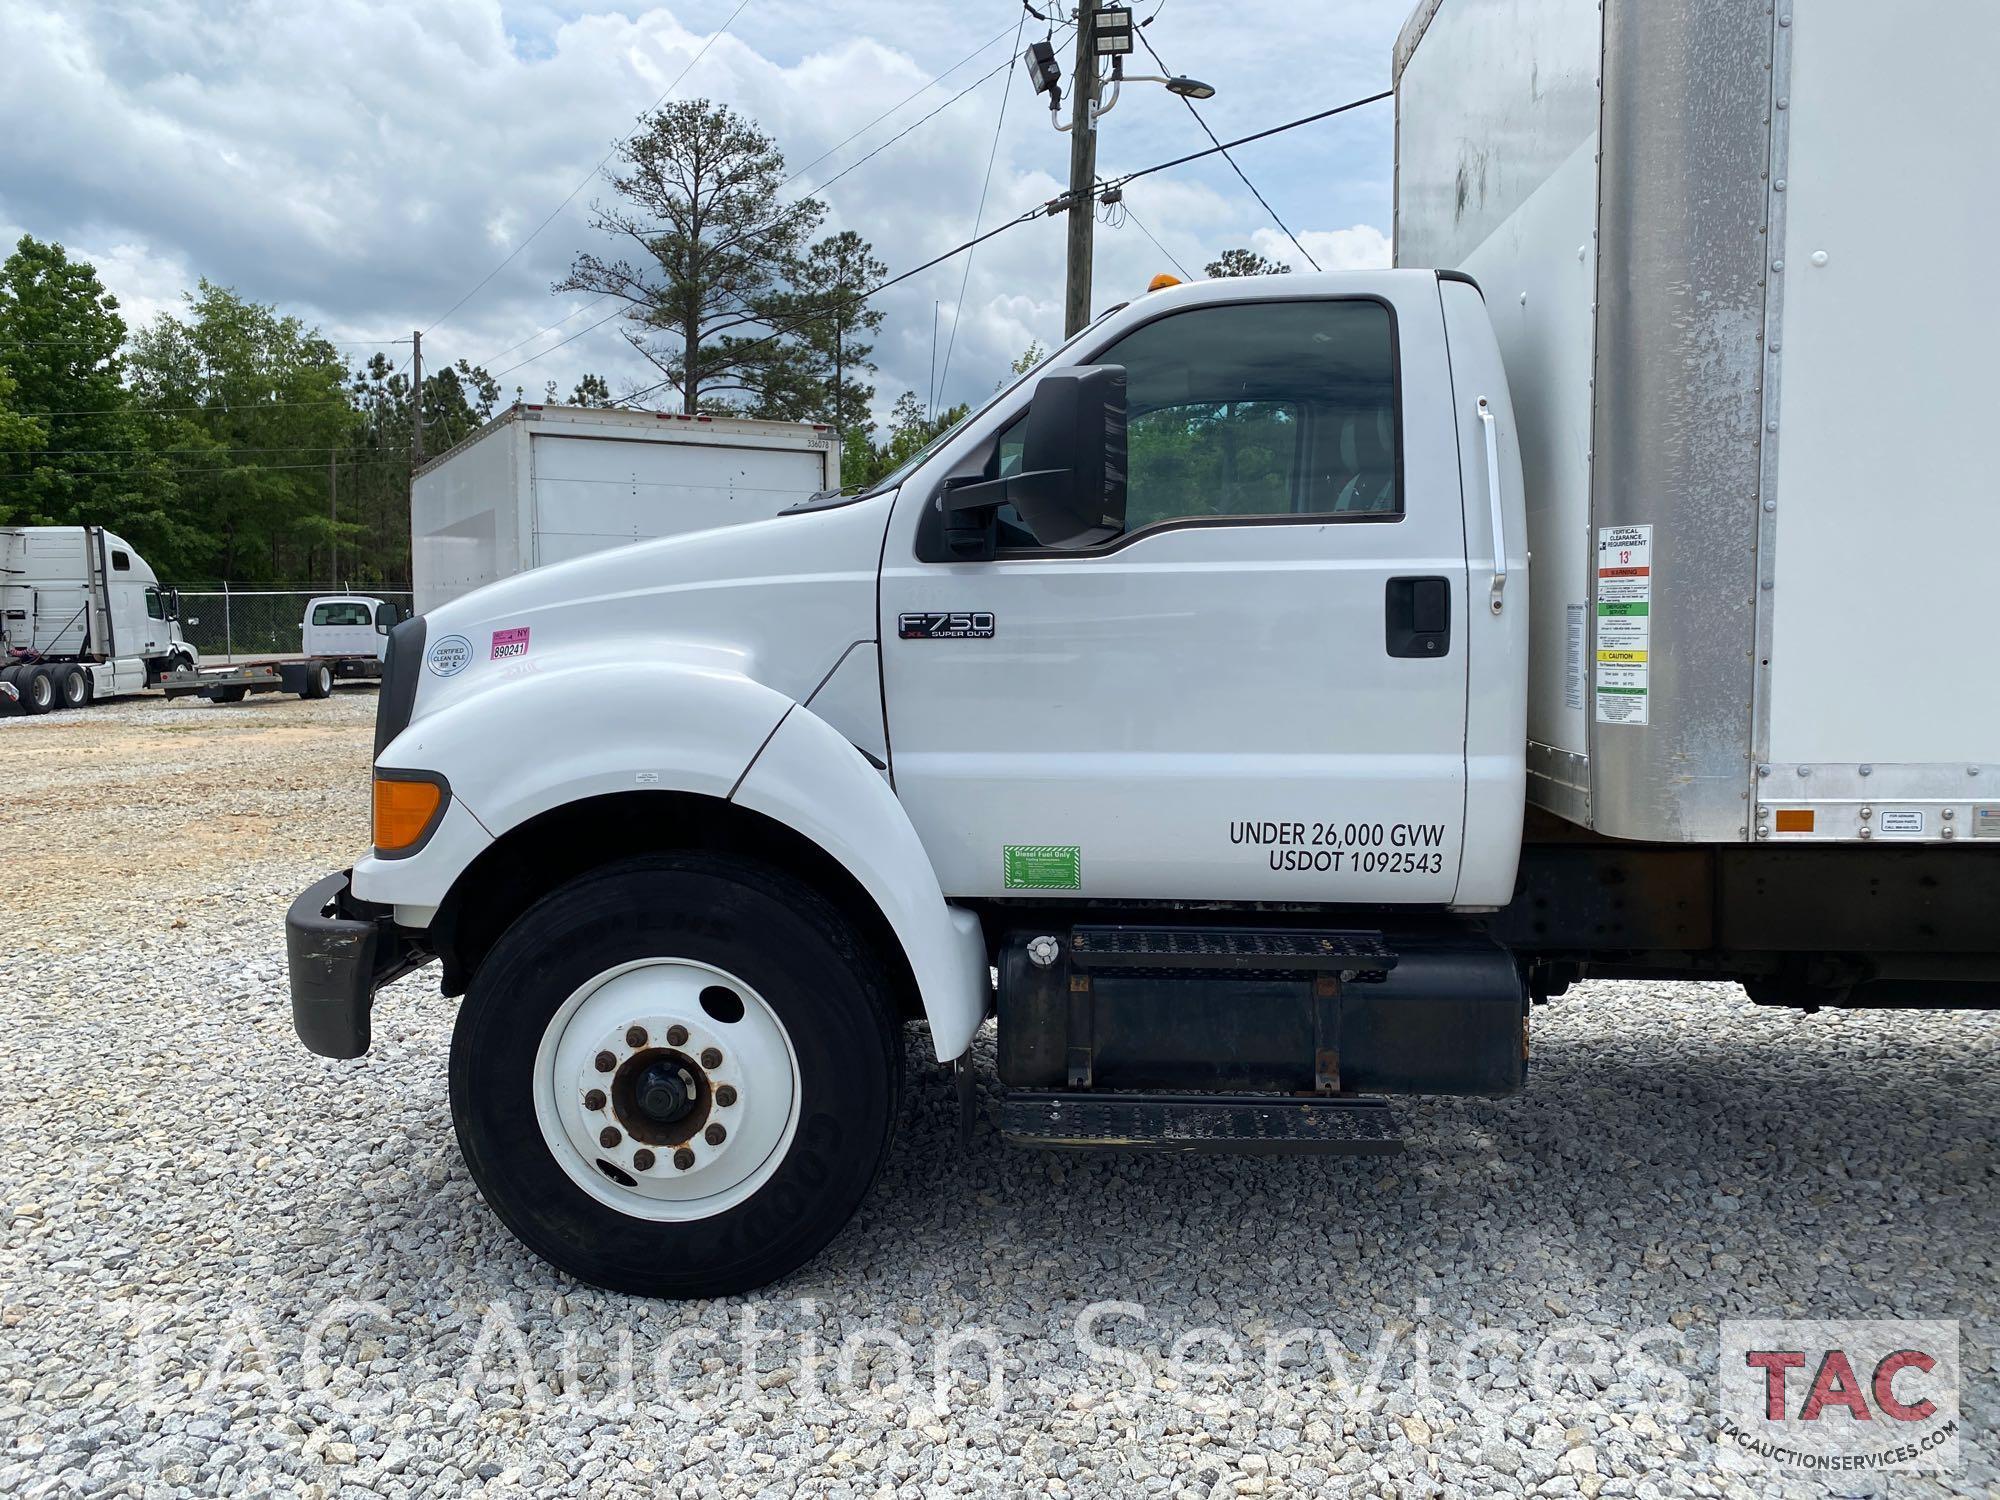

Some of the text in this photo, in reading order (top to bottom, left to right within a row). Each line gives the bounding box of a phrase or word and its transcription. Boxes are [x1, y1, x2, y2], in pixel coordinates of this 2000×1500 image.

[807, 439, 830, 449] 336078
[899, 613, 994, 632] F-750
[517, 629, 528, 637] NY
[494, 643, 524, 658] 890241
[1230, 821, 1445, 849] UNDER 26,000 GVW
[1054, 851, 1071, 859] Only
[1269, 850, 1443, 874] USDOT 1092543
